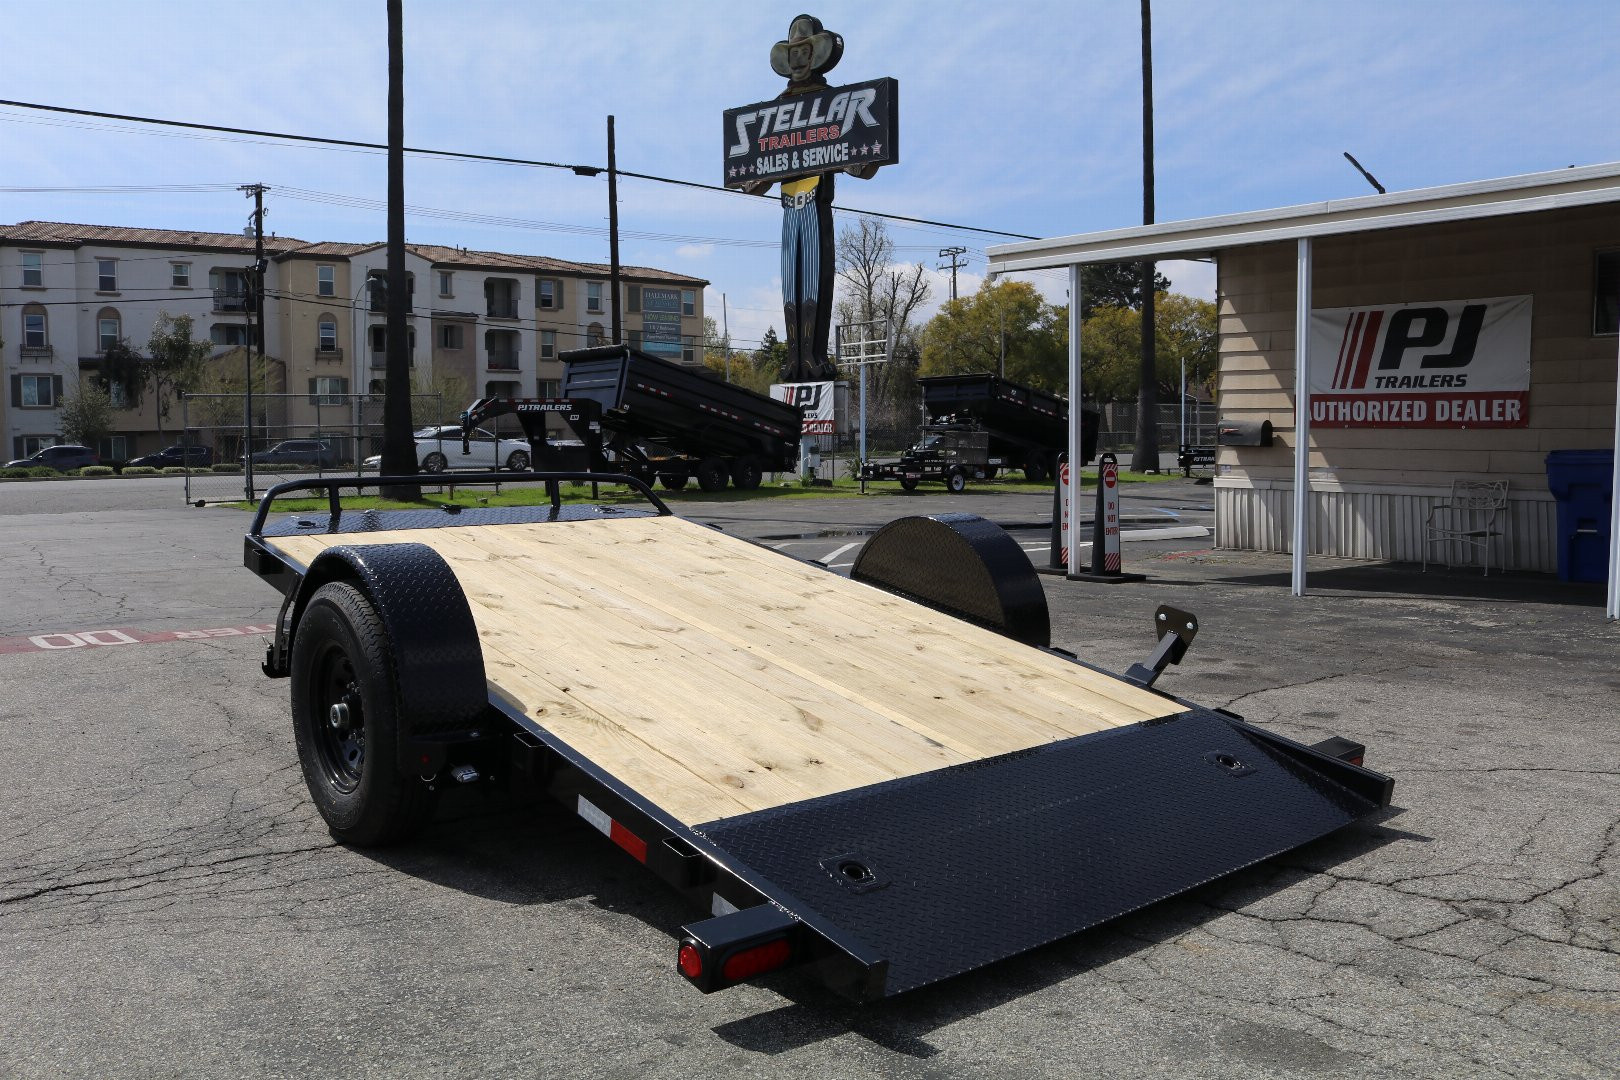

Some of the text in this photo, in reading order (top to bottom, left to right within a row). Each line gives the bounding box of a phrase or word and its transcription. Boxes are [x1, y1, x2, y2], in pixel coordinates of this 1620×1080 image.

[729, 88, 880, 158] STELLAR
[758, 124, 841, 152] TRAILERS
[756, 142, 849, 175] SALES & SERVICE
[1378, 304, 1488, 371] PJ
[1374, 374, 1468, 389] TRAILERS
[794, 385, 823, 410] PJ
[1435, 399, 1521, 422] DEALER
[1108, 501, 1115, 510] DO
[1105, 527, 1119, 535] ENTER
